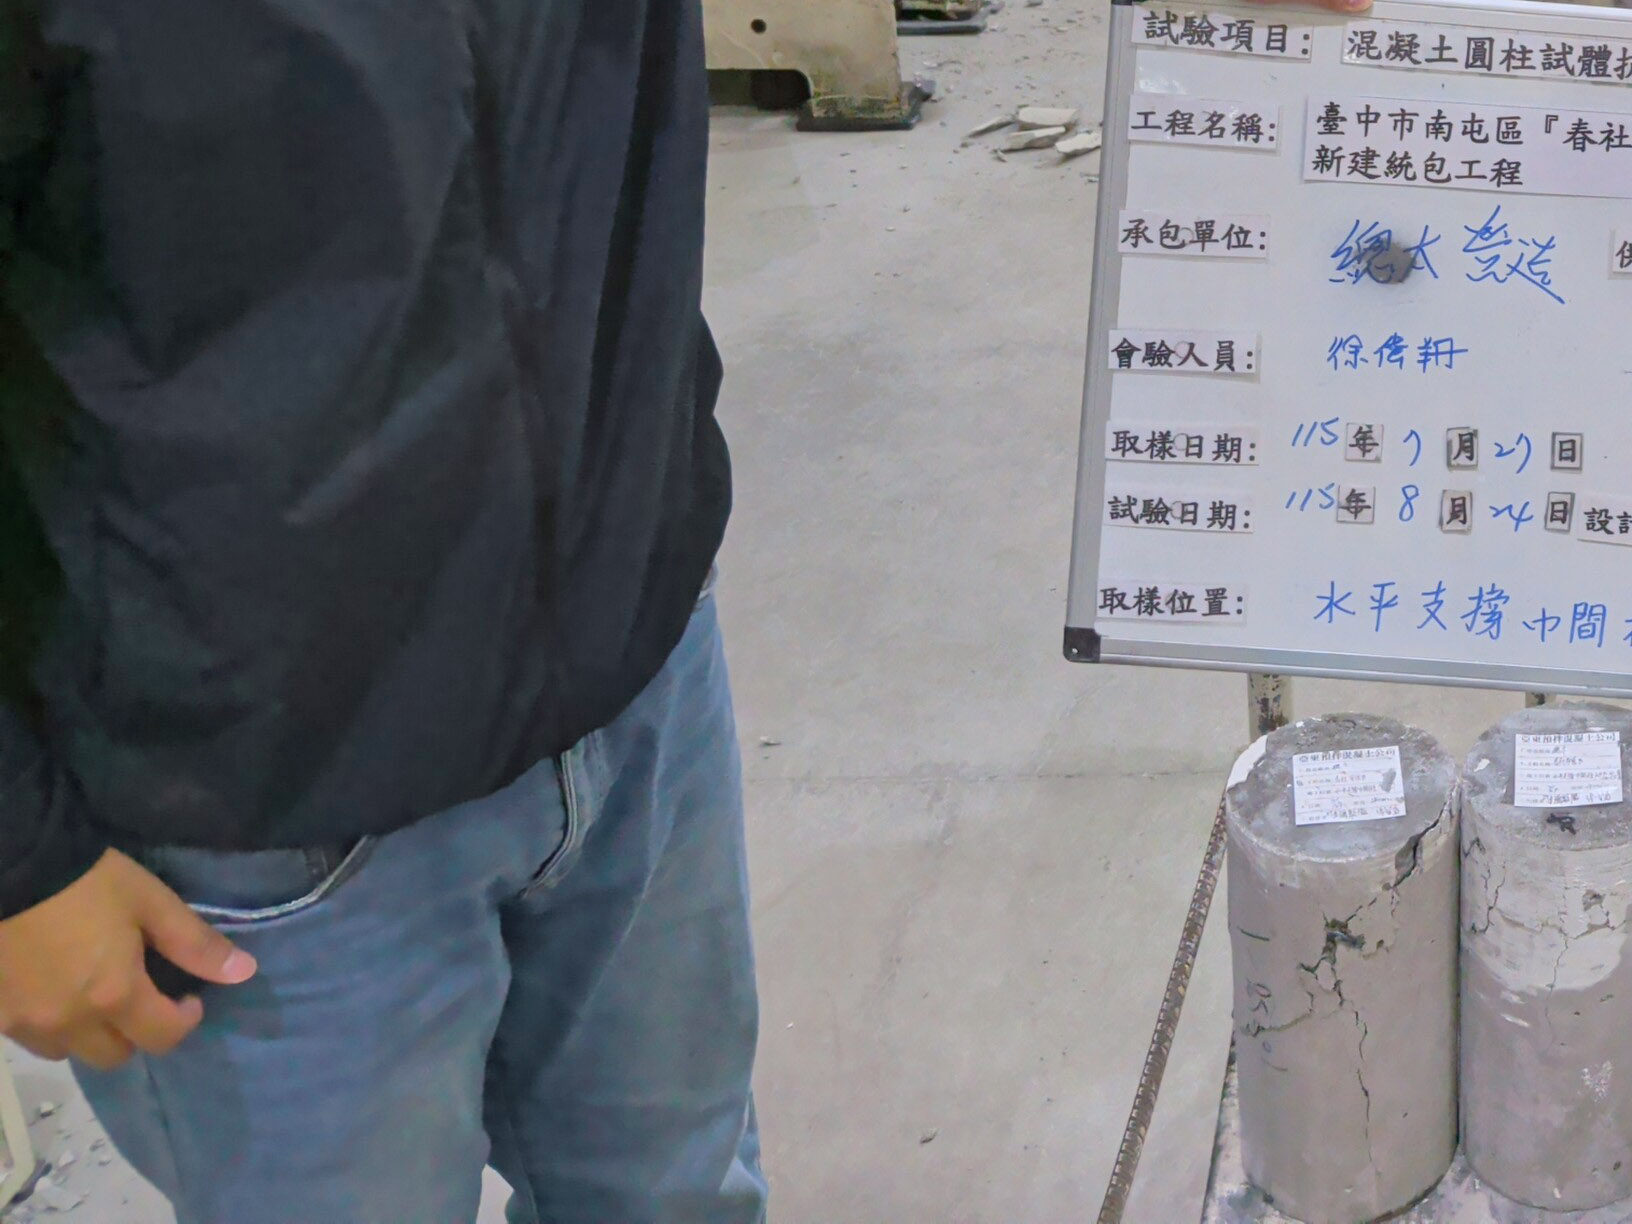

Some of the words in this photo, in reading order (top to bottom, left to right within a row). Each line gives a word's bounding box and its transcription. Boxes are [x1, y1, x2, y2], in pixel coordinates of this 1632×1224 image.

[1143, 11, 1310, 56] 試驗項目：
[1130, 109, 1276, 144] 工程名稱：
[1311, 144, 1524, 187] 新建統包工程
[1120, 217, 1267, 253] 承包單位：
[1111, 337, 1253, 373] 會驗人員：
[1111, 429, 1256, 464] 取樣日期：
[1290, 417, 1339, 447] 115
[1348, 424, 1380, 458] 年
[1452, 432, 1476, 462] 月
[1558, 438, 1577, 463] 日
[1107, 495, 1251, 530] 試驗日期：
[1340, 488, 1372, 520] 年
[1398, 484, 1420, 522] 8
[1446, 495, 1468, 526] 月
[1549, 500, 1569, 524] 日
[1098, 585, 1243, 617] 取樣位置：
